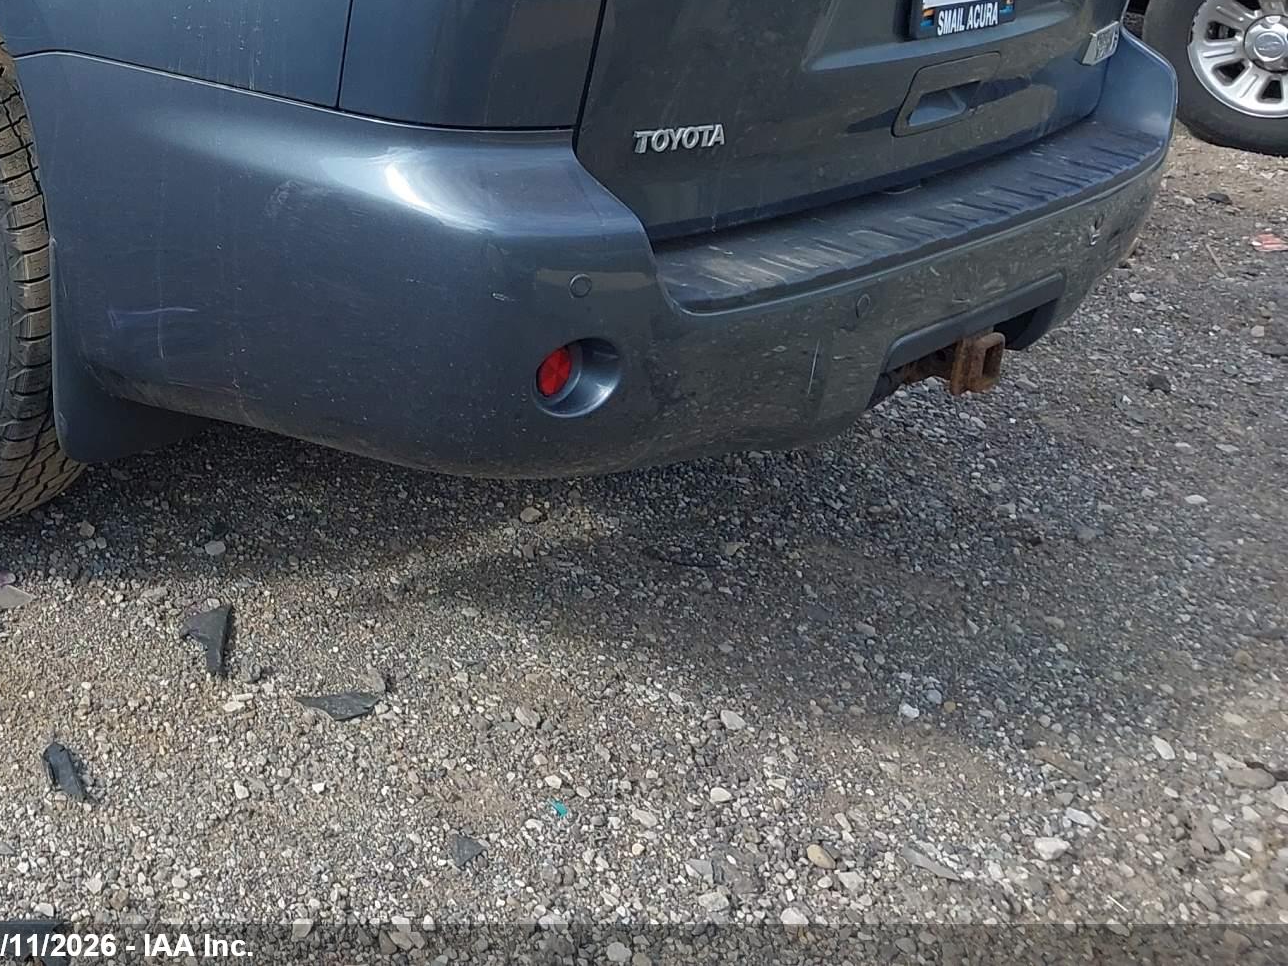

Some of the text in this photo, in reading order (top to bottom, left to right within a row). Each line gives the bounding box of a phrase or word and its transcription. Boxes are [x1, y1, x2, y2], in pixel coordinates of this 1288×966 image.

[937, 2, 999, 36] SMAIL ACURA
[633, 124, 725, 153] TOYOTA
